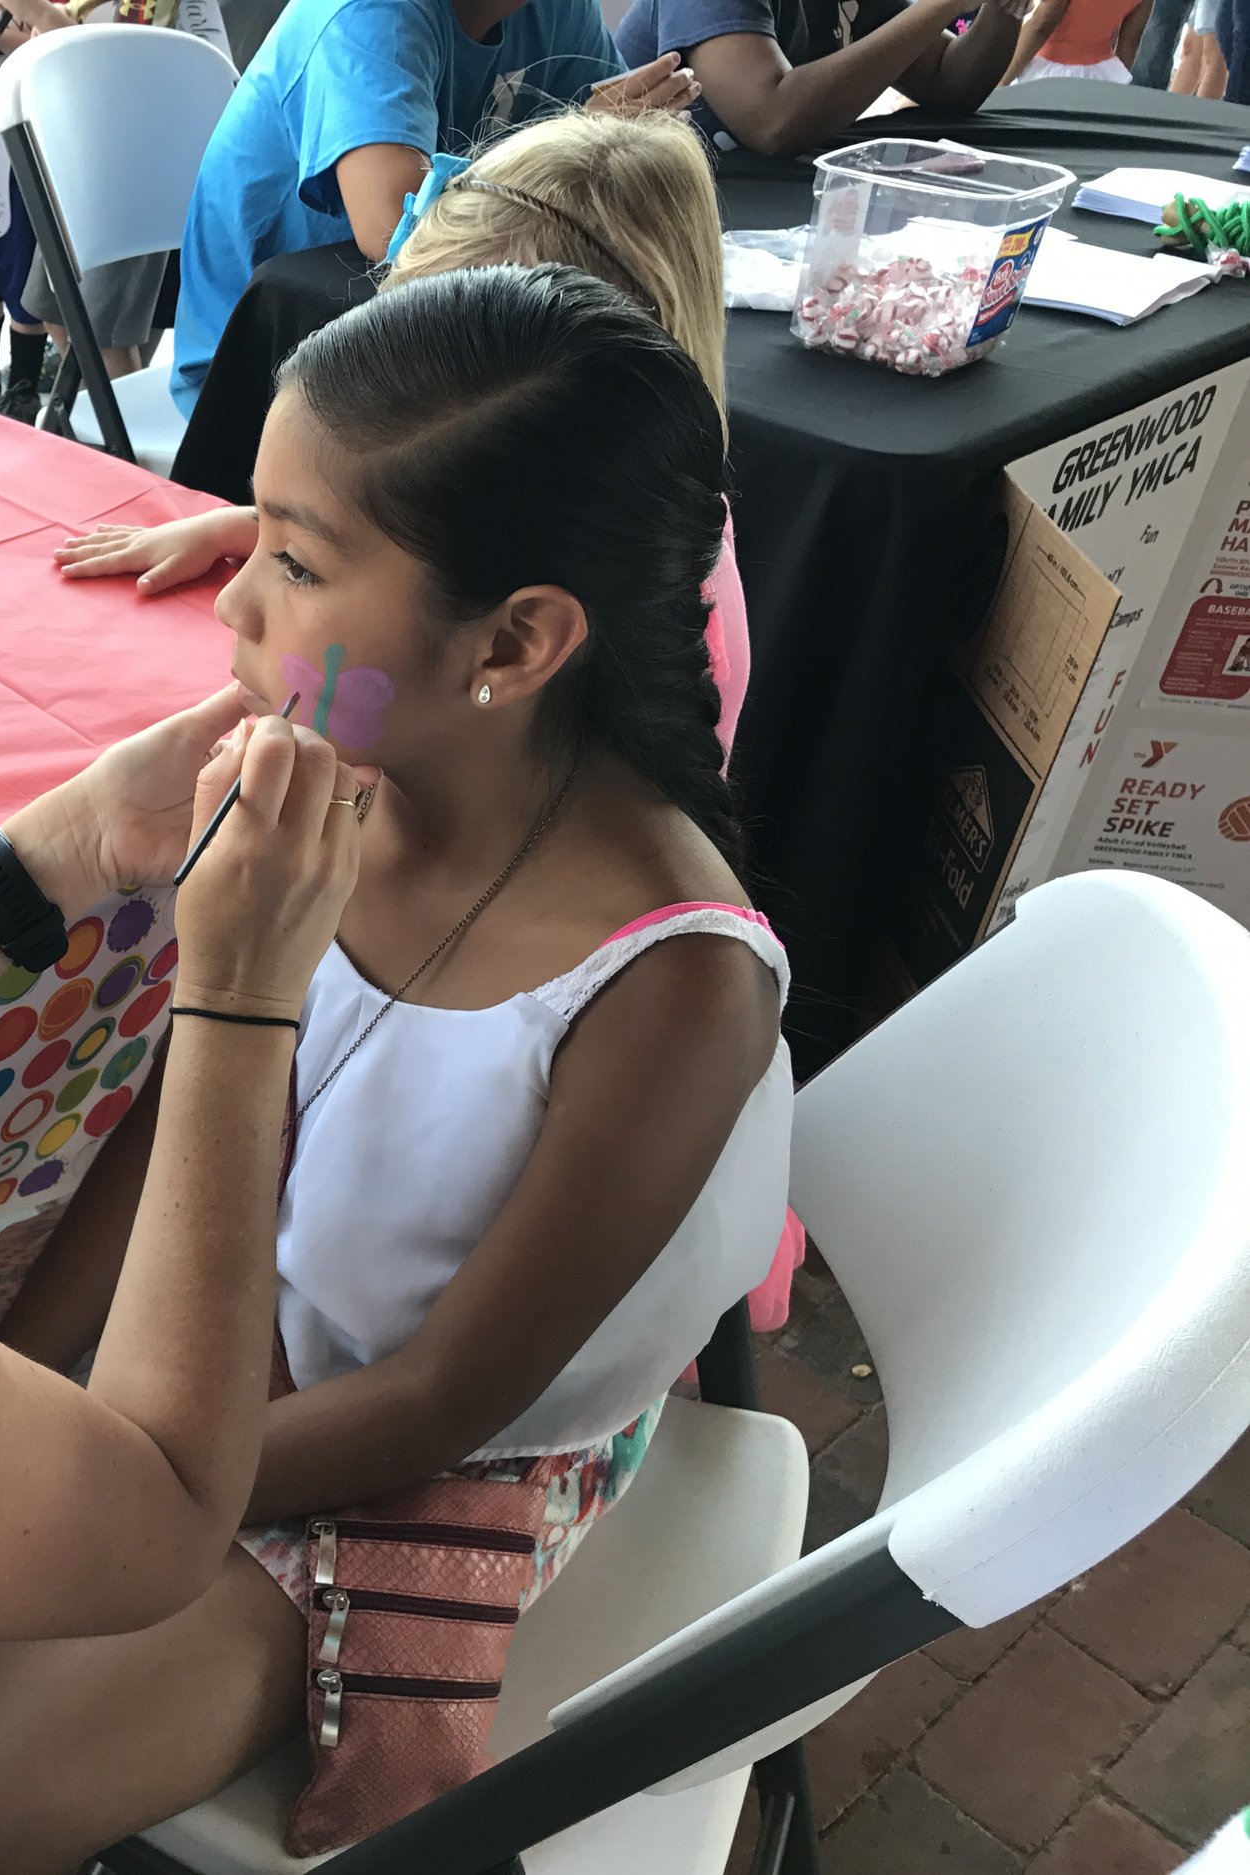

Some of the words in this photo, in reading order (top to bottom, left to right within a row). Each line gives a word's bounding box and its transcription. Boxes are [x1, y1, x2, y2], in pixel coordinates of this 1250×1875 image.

[1052, 385, 1217, 495] GREENWOOD
[1043, 474, 1122, 532] AMILY
[1124, 435, 1203, 506] YMCA
[1139, 524, 1159, 544] Fun
[1120, 778, 1206, 800] READY
[1111, 797, 1160, 816] SET
[1103, 817, 1175, 838] SPIKE
